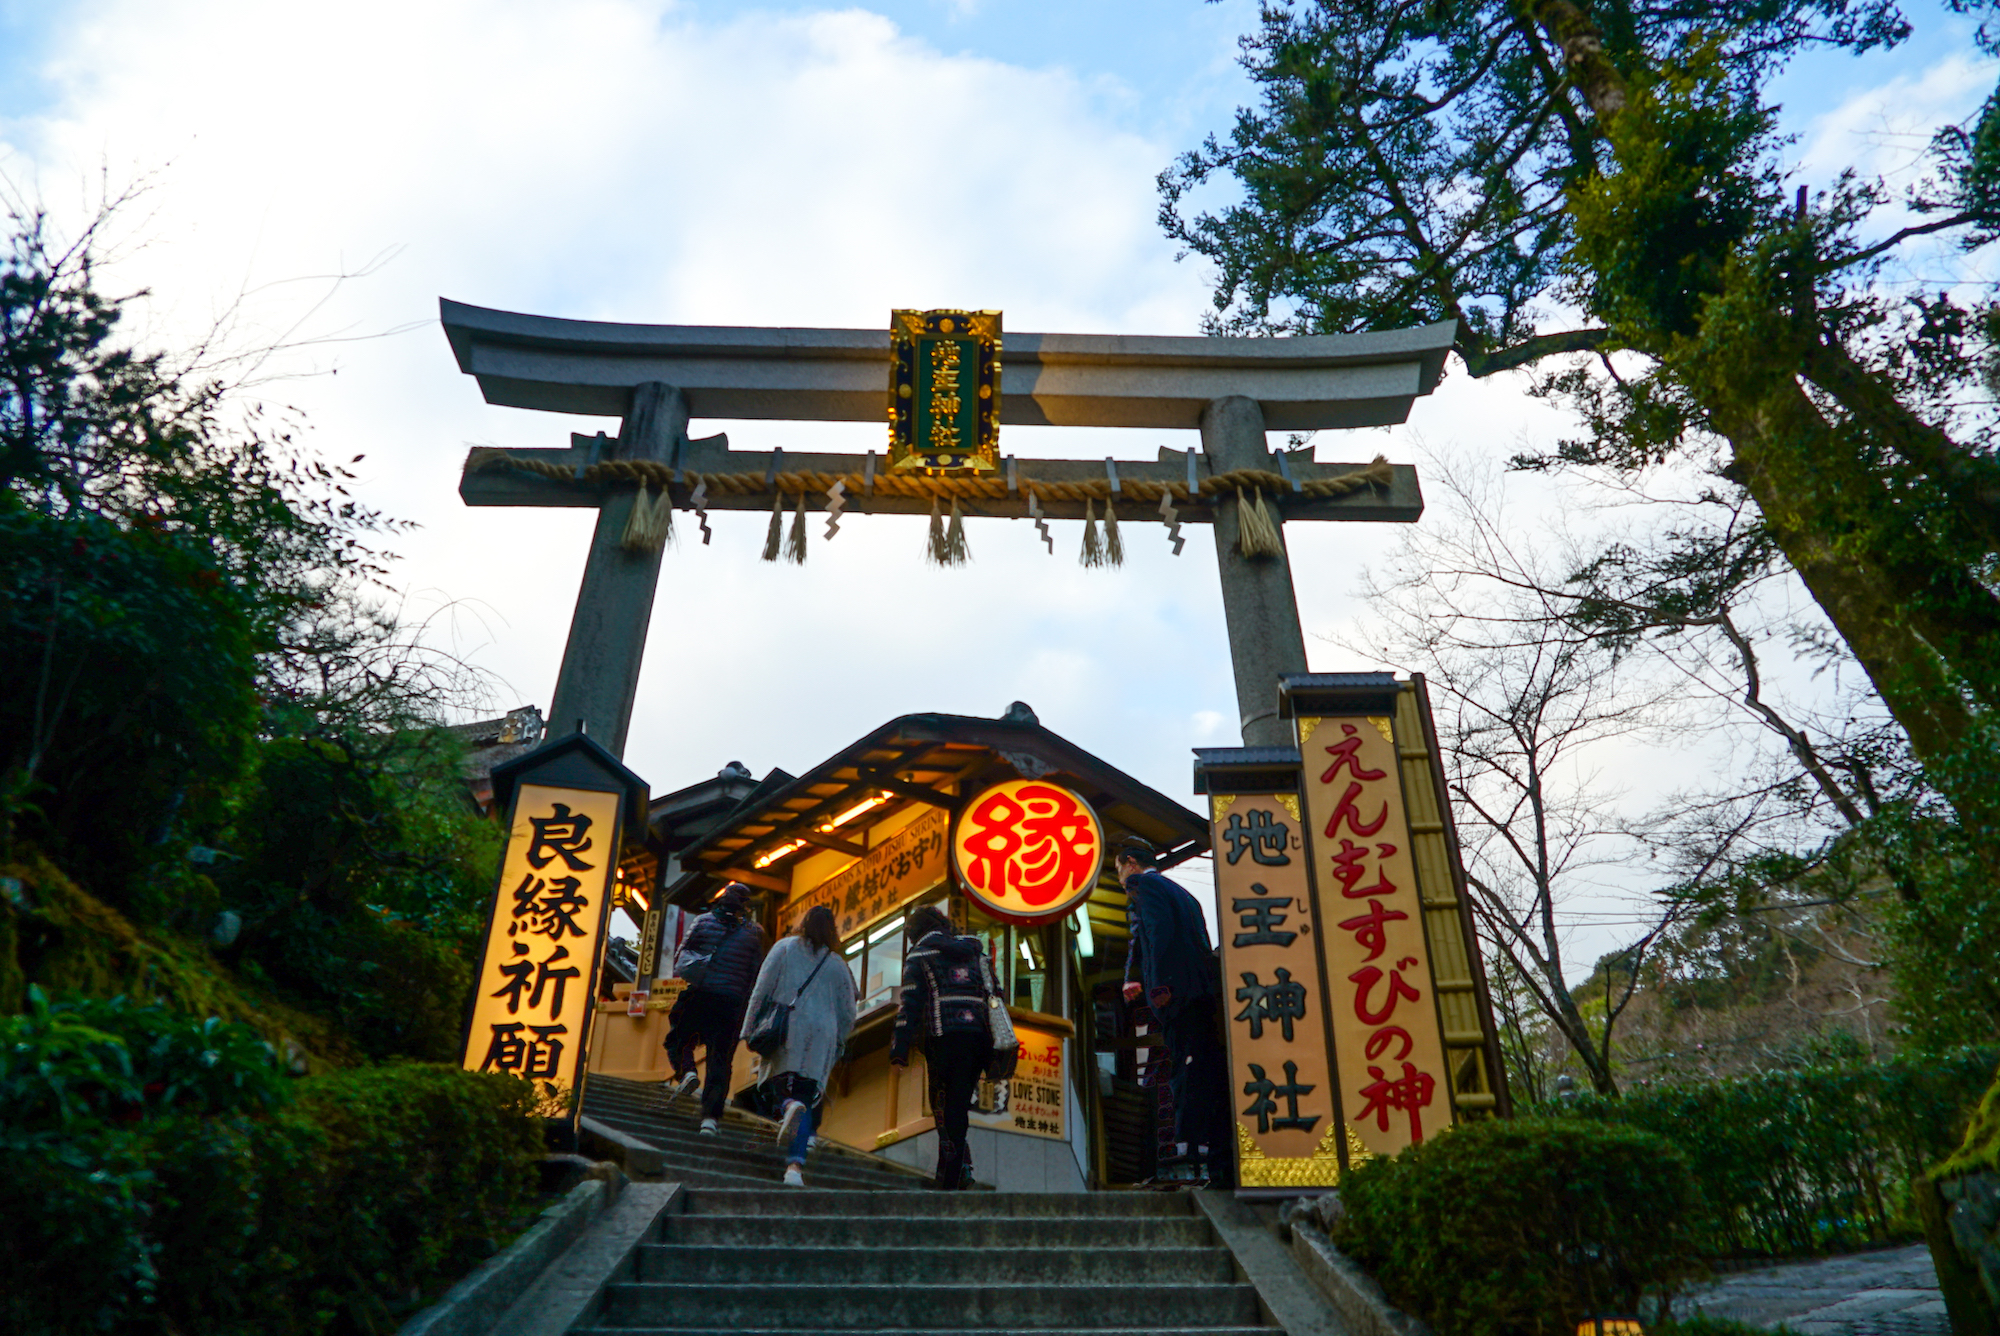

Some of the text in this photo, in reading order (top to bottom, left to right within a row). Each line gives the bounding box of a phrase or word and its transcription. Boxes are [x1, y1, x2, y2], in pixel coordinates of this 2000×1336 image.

[821, 871, 854, 899] CHARMS
[855, 853, 882, 878] KYOTO
[884, 836, 909, 861] JISHU
[910, 811, 943, 838] SHRINE
[845, 830, 942, 912] 縁結びお守り
[964, 786, 1094, 906] 縁
[480, 803, 596, 1098] 良縁祈願
[1224, 809, 1321, 1134] 地主神社
[1321, 724, 1434, 1142] えんむすびの神
[1013, 1082, 1033, 1101] LOVE
[1036, 1086, 1061, 1107] STONE
[1015, 1116, 1060, 1135] 地主神社
